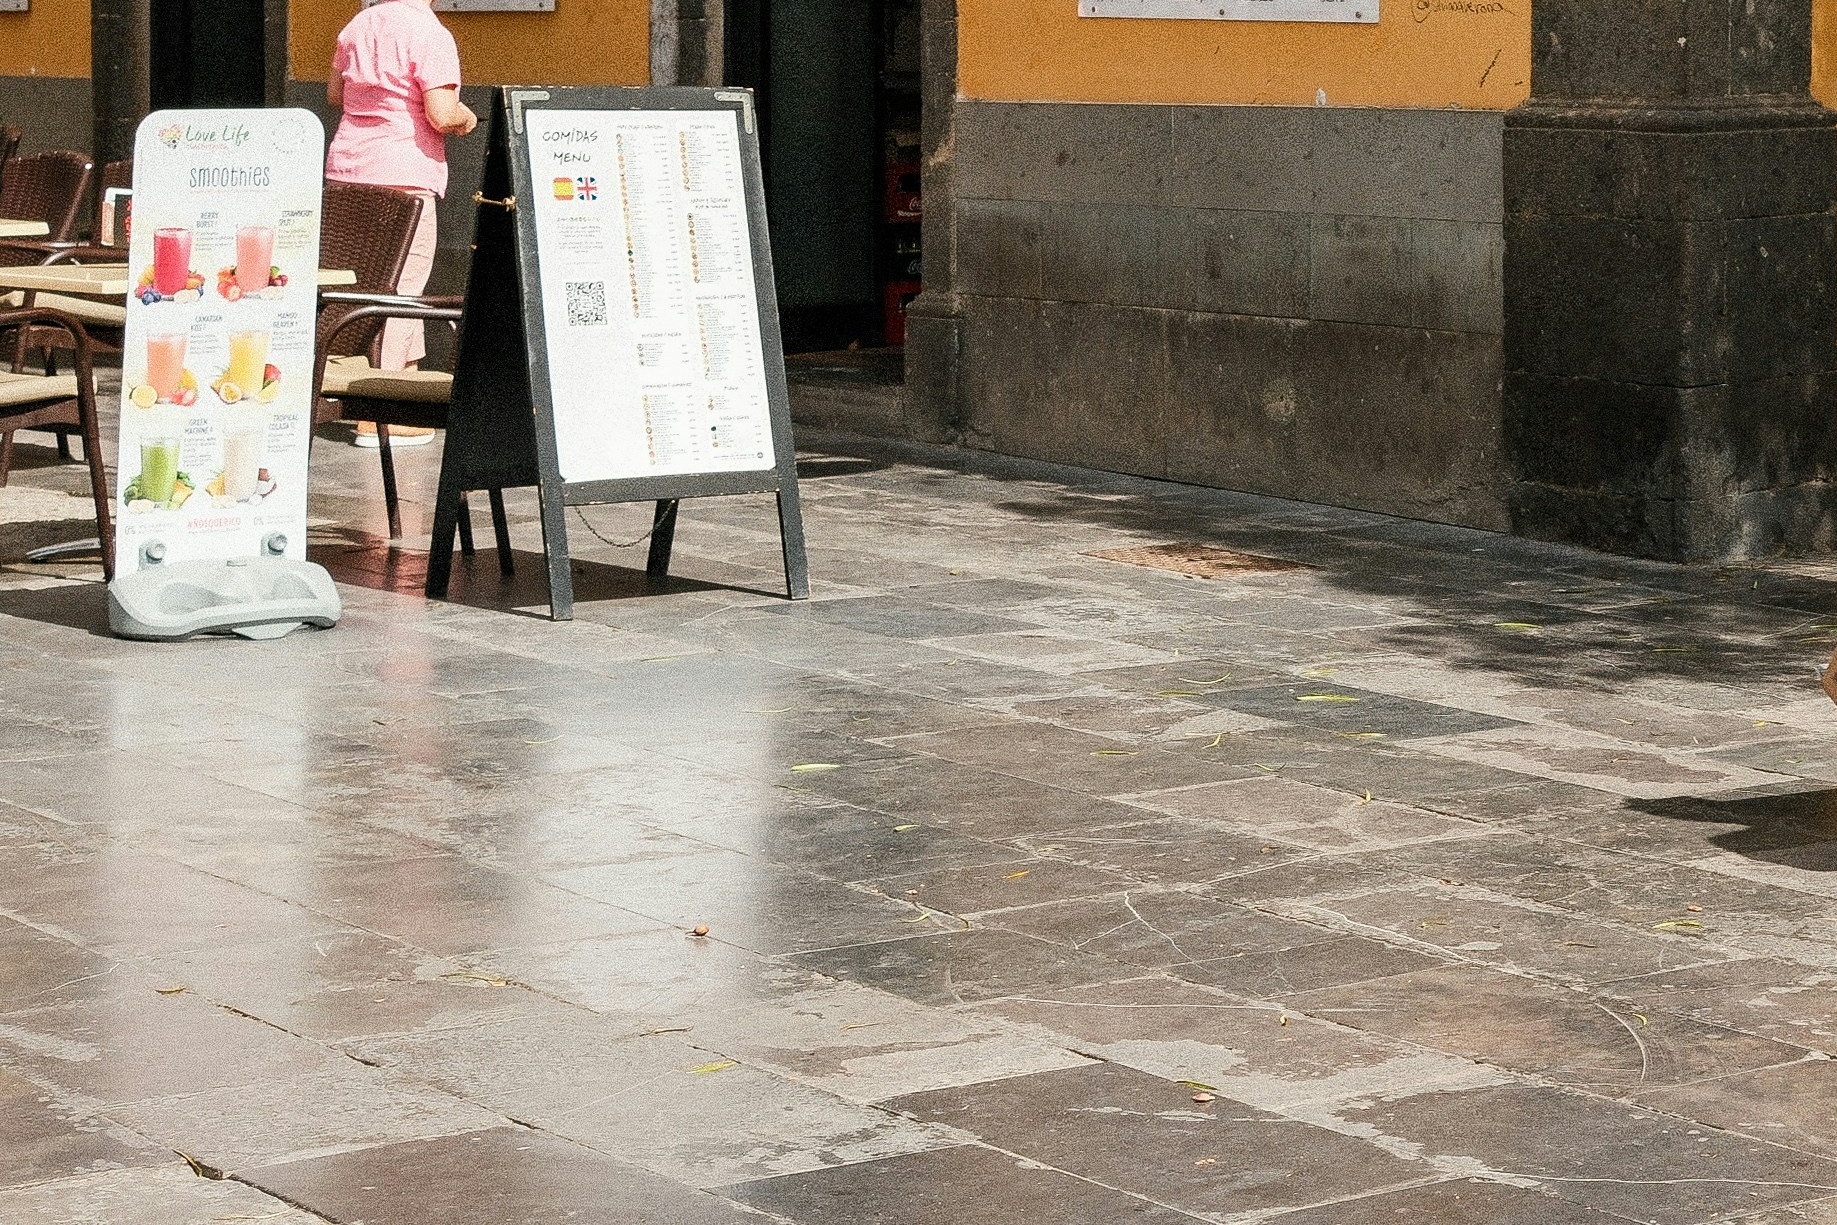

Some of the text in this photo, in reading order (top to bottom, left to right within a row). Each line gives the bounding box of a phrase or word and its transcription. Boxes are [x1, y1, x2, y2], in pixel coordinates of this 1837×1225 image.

[185, 123, 250, 147] Love Life
[553, 151, 591, 165] MENU
[189, 166, 271, 189] smoothies
